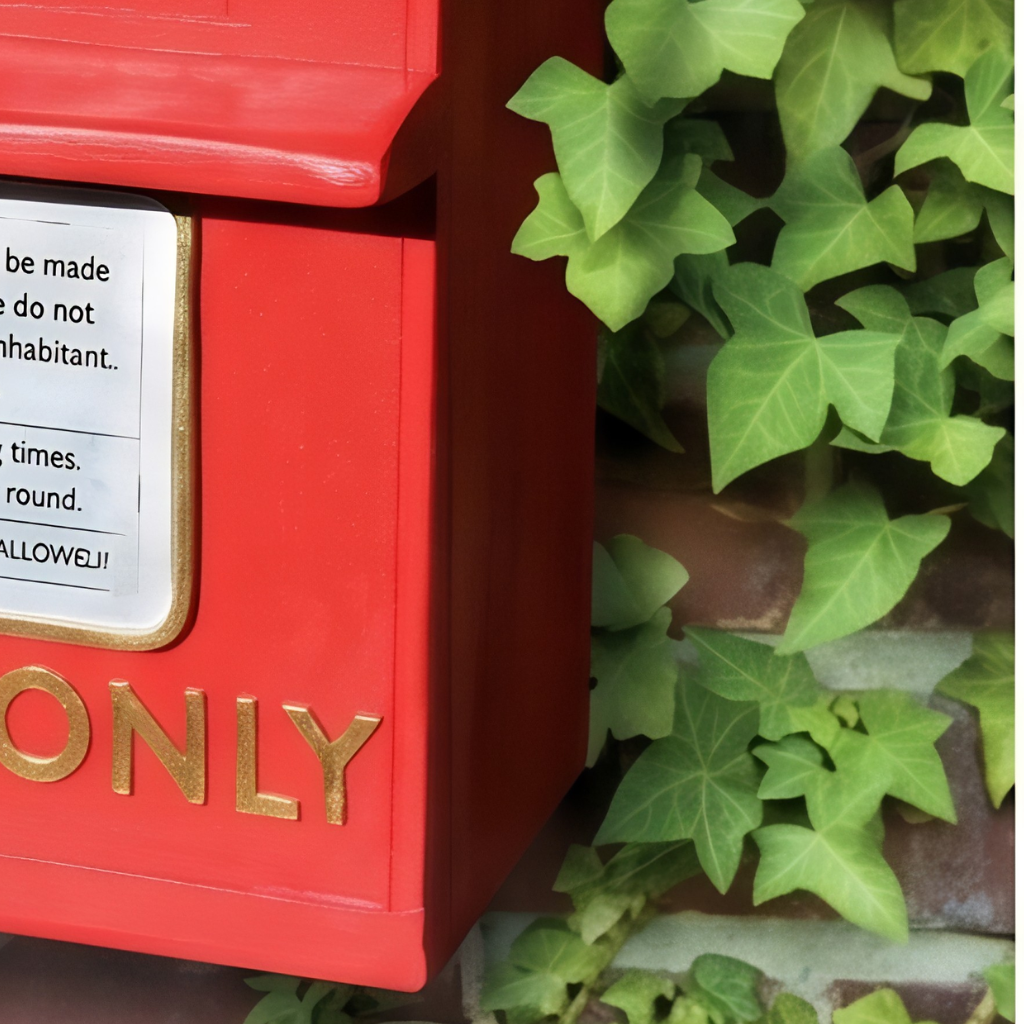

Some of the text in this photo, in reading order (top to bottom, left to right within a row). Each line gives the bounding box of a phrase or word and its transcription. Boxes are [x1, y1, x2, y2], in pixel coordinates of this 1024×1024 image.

[5, 246, 35, 275] be
[43, 255, 110, 282] made
[13, 292, 45, 320] do
[53, 302, 96, 325] not
[10, 440, 81, 471] times.
[6, 487, 82, 512] round.
